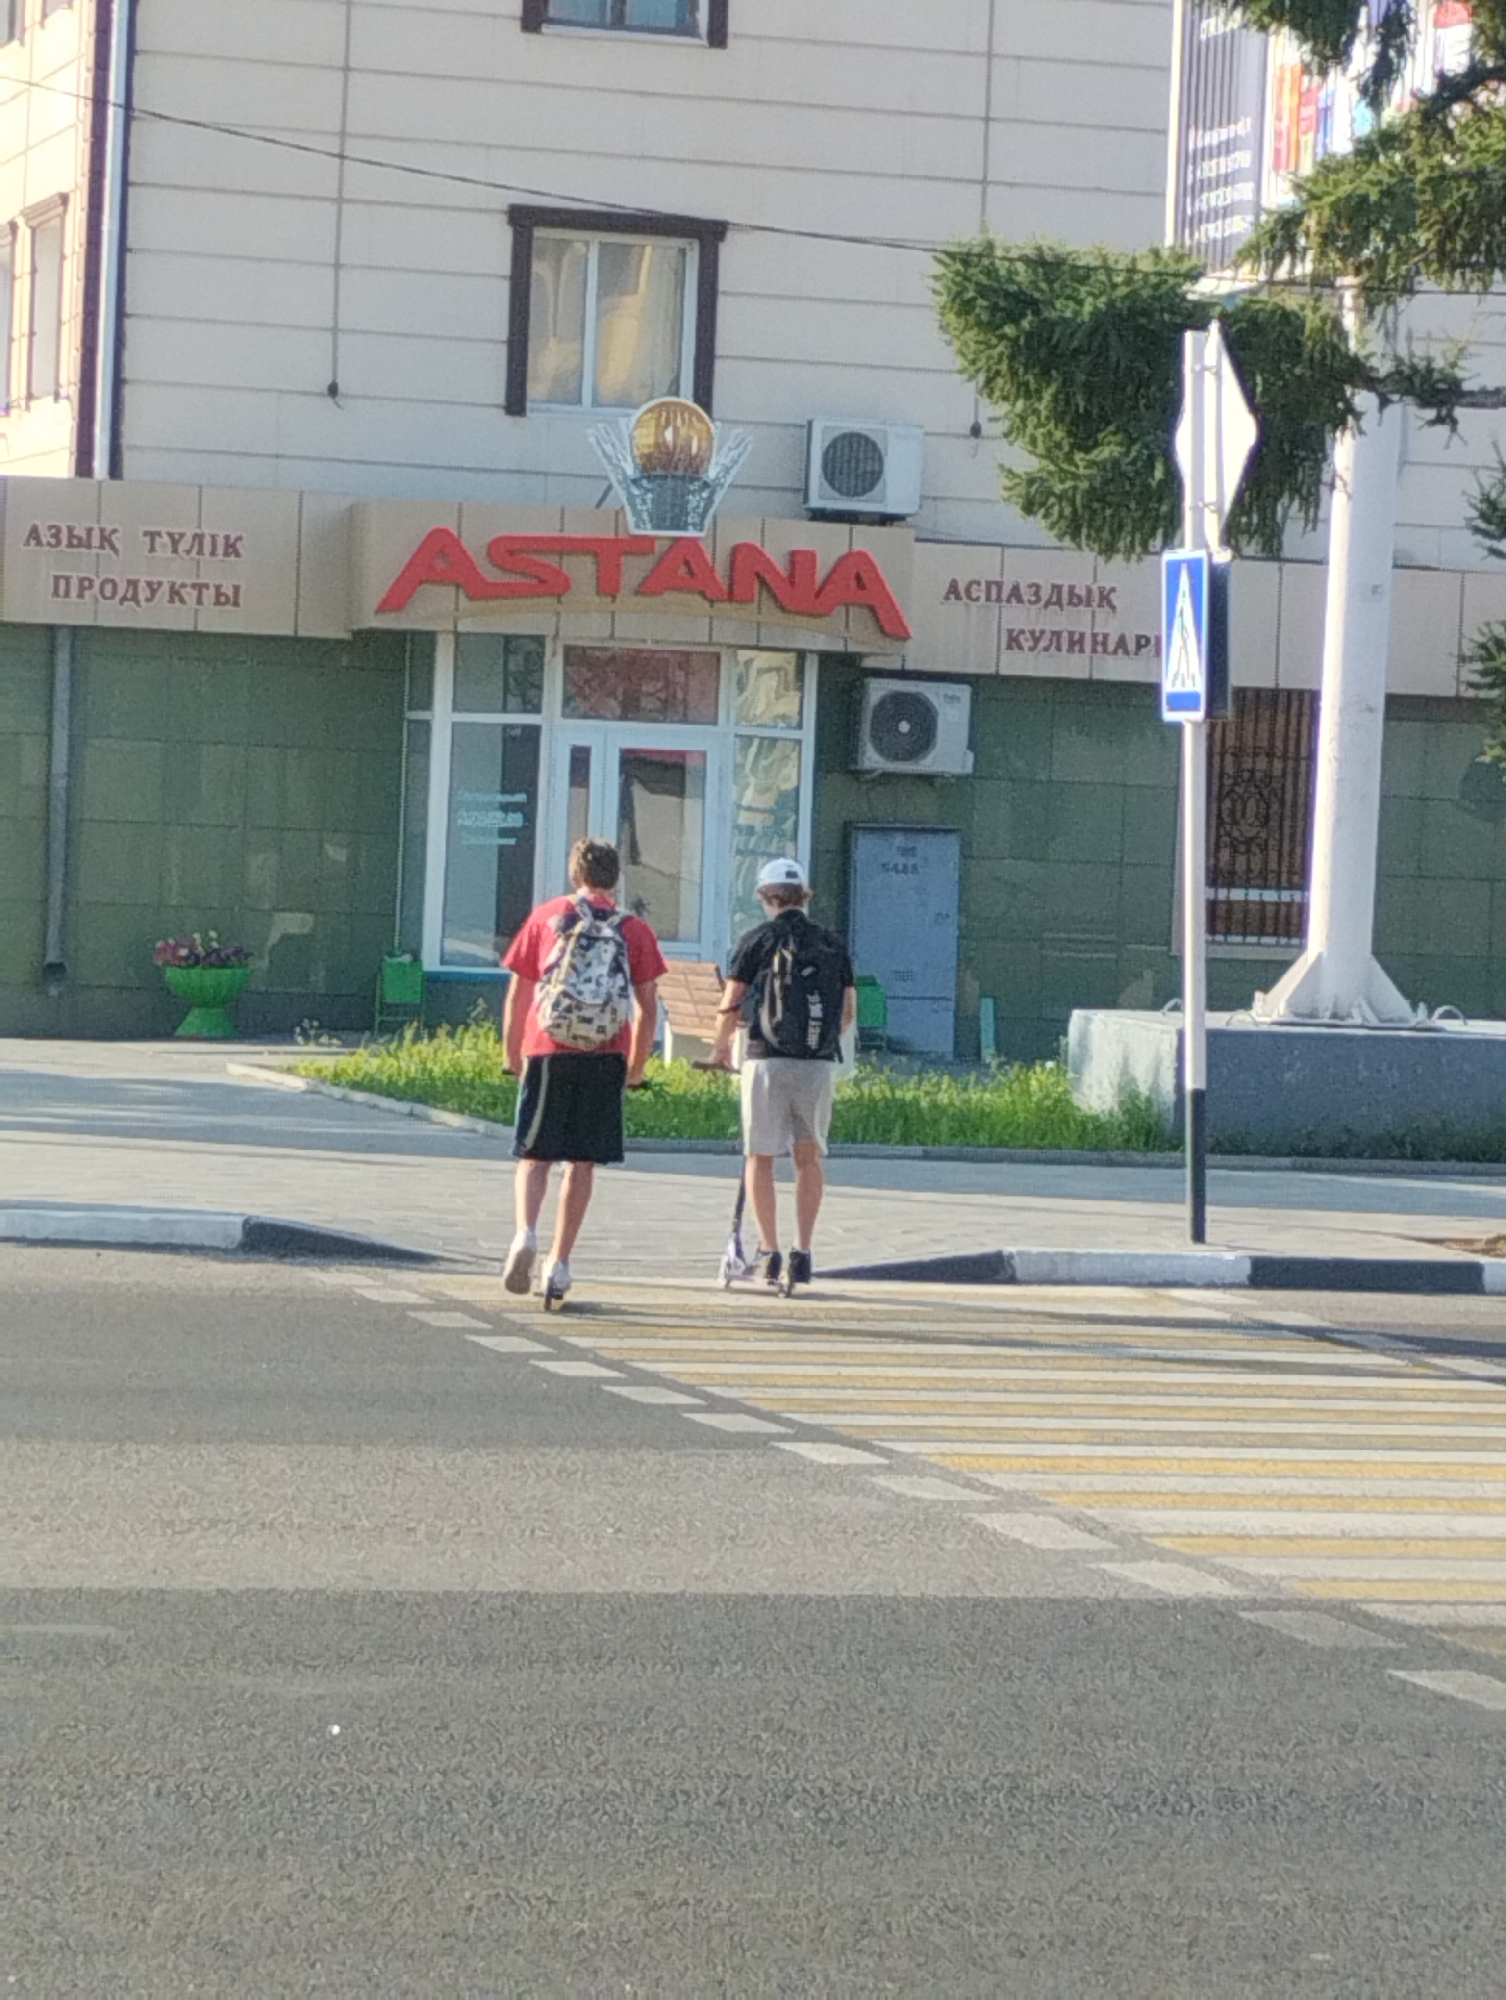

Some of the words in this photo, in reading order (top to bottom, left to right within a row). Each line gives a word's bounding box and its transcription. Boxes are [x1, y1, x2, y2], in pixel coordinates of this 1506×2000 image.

[22, 523, 120, 556] АЗЫҚ
[142, 530, 244, 559] ТҮЛІК
[50, 574, 241, 608] ПРОДУКТЫ
[374, 526, 913, 639] ASTANA
[943, 577, 1118, 613] АСПАЗДЫҚ
